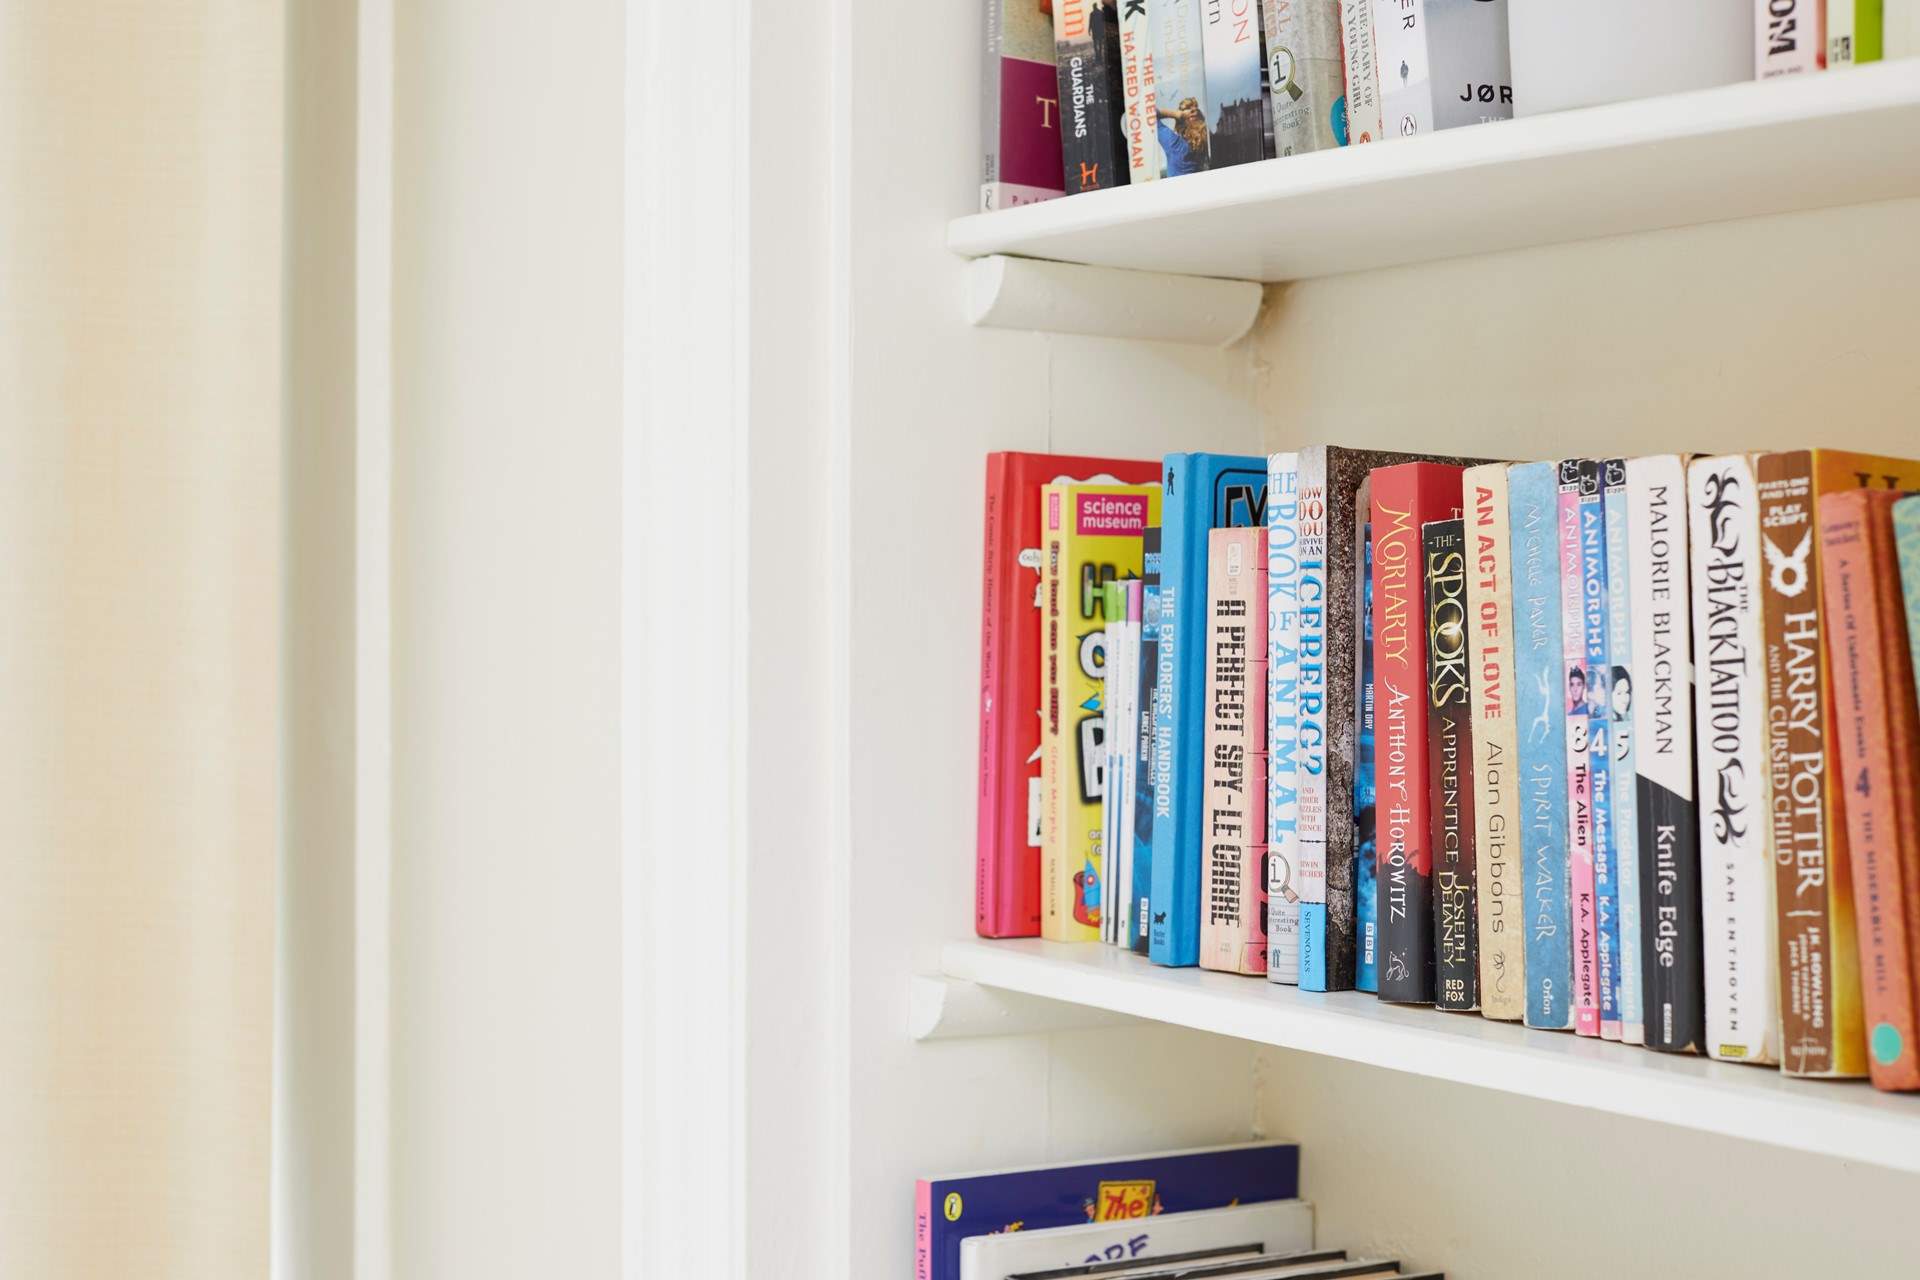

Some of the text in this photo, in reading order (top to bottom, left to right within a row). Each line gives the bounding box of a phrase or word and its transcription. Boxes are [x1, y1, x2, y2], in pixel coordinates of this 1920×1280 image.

[1143, 53, 1155, 88] THE
[1348, 17, 1360, 72] YOUNG
[1360, 33, 1371, 82] DIARY
[1069, 56, 1088, 139] GUARDIANS
[1085, 83, 1096, 106] THE
[1123, 31, 1145, 169] HATRED WOMAN
[1362, 86, 1374, 108] OF
[1083, 497, 1142, 516] science
[1083, 516, 1142, 529] museum
[1434, 534, 1456, 548] THE
[1768, 503, 1802, 517] PLAY
[1267, 500, 1297, 601] BOOK
[1376, 500, 1416, 668] MORIARTY
[1524, 503, 1550, 650] MICHELLE PAVER
[1583, 510, 1602, 657] ANIMORPHS
[1609, 508, 1626, 656] ANIMORPHS
[985, 579, 994, 613] History
[1217, 599, 1247, 617] A
[1476, 486, 1502, 720] AN ACT OF LOVE
[1648, 485, 1674, 756] MALORIE BLACKMAN
[1739, 584, 1749, 614] THE
[1840, 572, 1854, 611] Series
[984, 651, 992, 679] World
[1156, 586, 1175, 818] THE EXPLORERS' HANDBOOK
[1215, 625, 1246, 736] PERFECT
[1299, 559, 1324, 776] ICEBERG?
[1846, 634, 1864, 712] Unfortunate
[1141, 710, 1150, 735] LANCE
[1274, 640, 1298, 845] ANIMAL
[1364, 683, 1374, 730] MARTIN DAY
[1589, 727, 1608, 757] 4
[1854, 715, 1869, 760] Events
[1214, 744, 1245, 793] SPY
[1440, 716, 1459, 863] APPRENTICE
[1768, 644, 1794, 866] AND THE CURSED CHILD
[1783, 609, 1826, 897] HARRY POTTER
[1213, 809, 1243, 839] LE
[1387, 676, 1412, 924] ANTHONY HOROWITZ
[1487, 740, 1507, 934] Alan Gibbons
[1575, 763, 1588, 847] The Alien
[1594, 769, 1609, 885] The Message
[1618, 772, 1634, 886] The Predator
[1531, 763, 1557, 942] SPIRIT WALKER
[1726, 863, 1736, 903] SAM
[1438, 871, 1455, 969] DELANEY
[1453, 873, 1469, 963] JOSEPH
[1579, 892, 1591, 923] K.A.
[1654, 824, 1677, 968] Knife Edge
[1861, 810, 1888, 995] THE MISERABLE MILL
[1365, 922, 1375, 964] BBC
[1580, 928, 1592, 1007] Applegate
[1599, 895, 1613, 1011] K.A. Applegate
[1726, 917, 1739, 1033] ENTHOVEN
[1788, 940, 1801, 1015] JACK THORNE
[1797, 934, 1809, 962] JOHN
[1446, 979, 1464, 990] RED
[1446, 991, 1465, 1002] FOX
[1542, 977, 1554, 1015] Orion
[1799, 963, 1810, 1011] TIFFANY
[1810, 952, 1824, 1029] ROWLING
[918, 1212, 928, 1242] The
[1104, 1188, 1146, 1219] The
